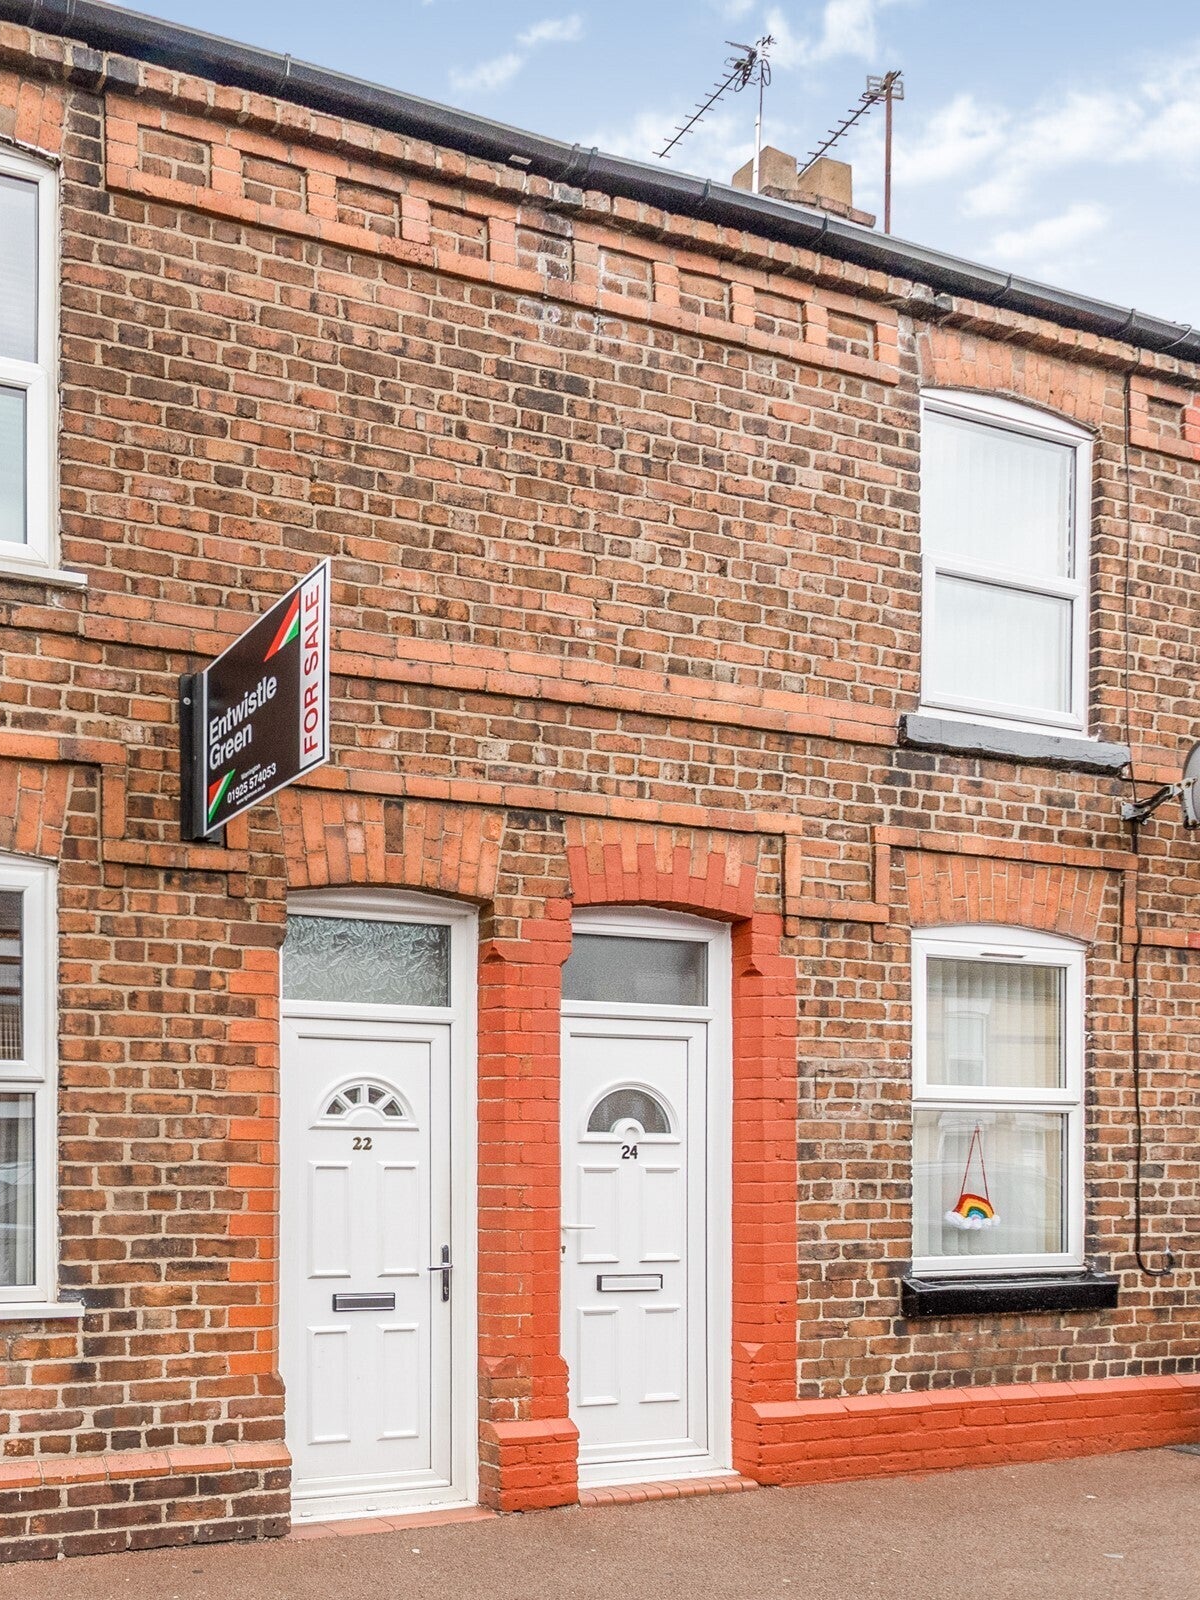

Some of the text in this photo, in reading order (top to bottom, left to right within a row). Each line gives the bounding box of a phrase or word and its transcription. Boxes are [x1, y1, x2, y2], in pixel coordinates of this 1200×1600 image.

[304, 585, 319, 755] FOR SALE
[209, 676, 278, 746] Entwistle
[209, 723, 253, 770] Green
[227, 781, 248, 803] 01925
[249, 762, 276, 789] 574053
[352, 1136, 373, 1151] 22
[621, 1144, 639, 1160] 24
